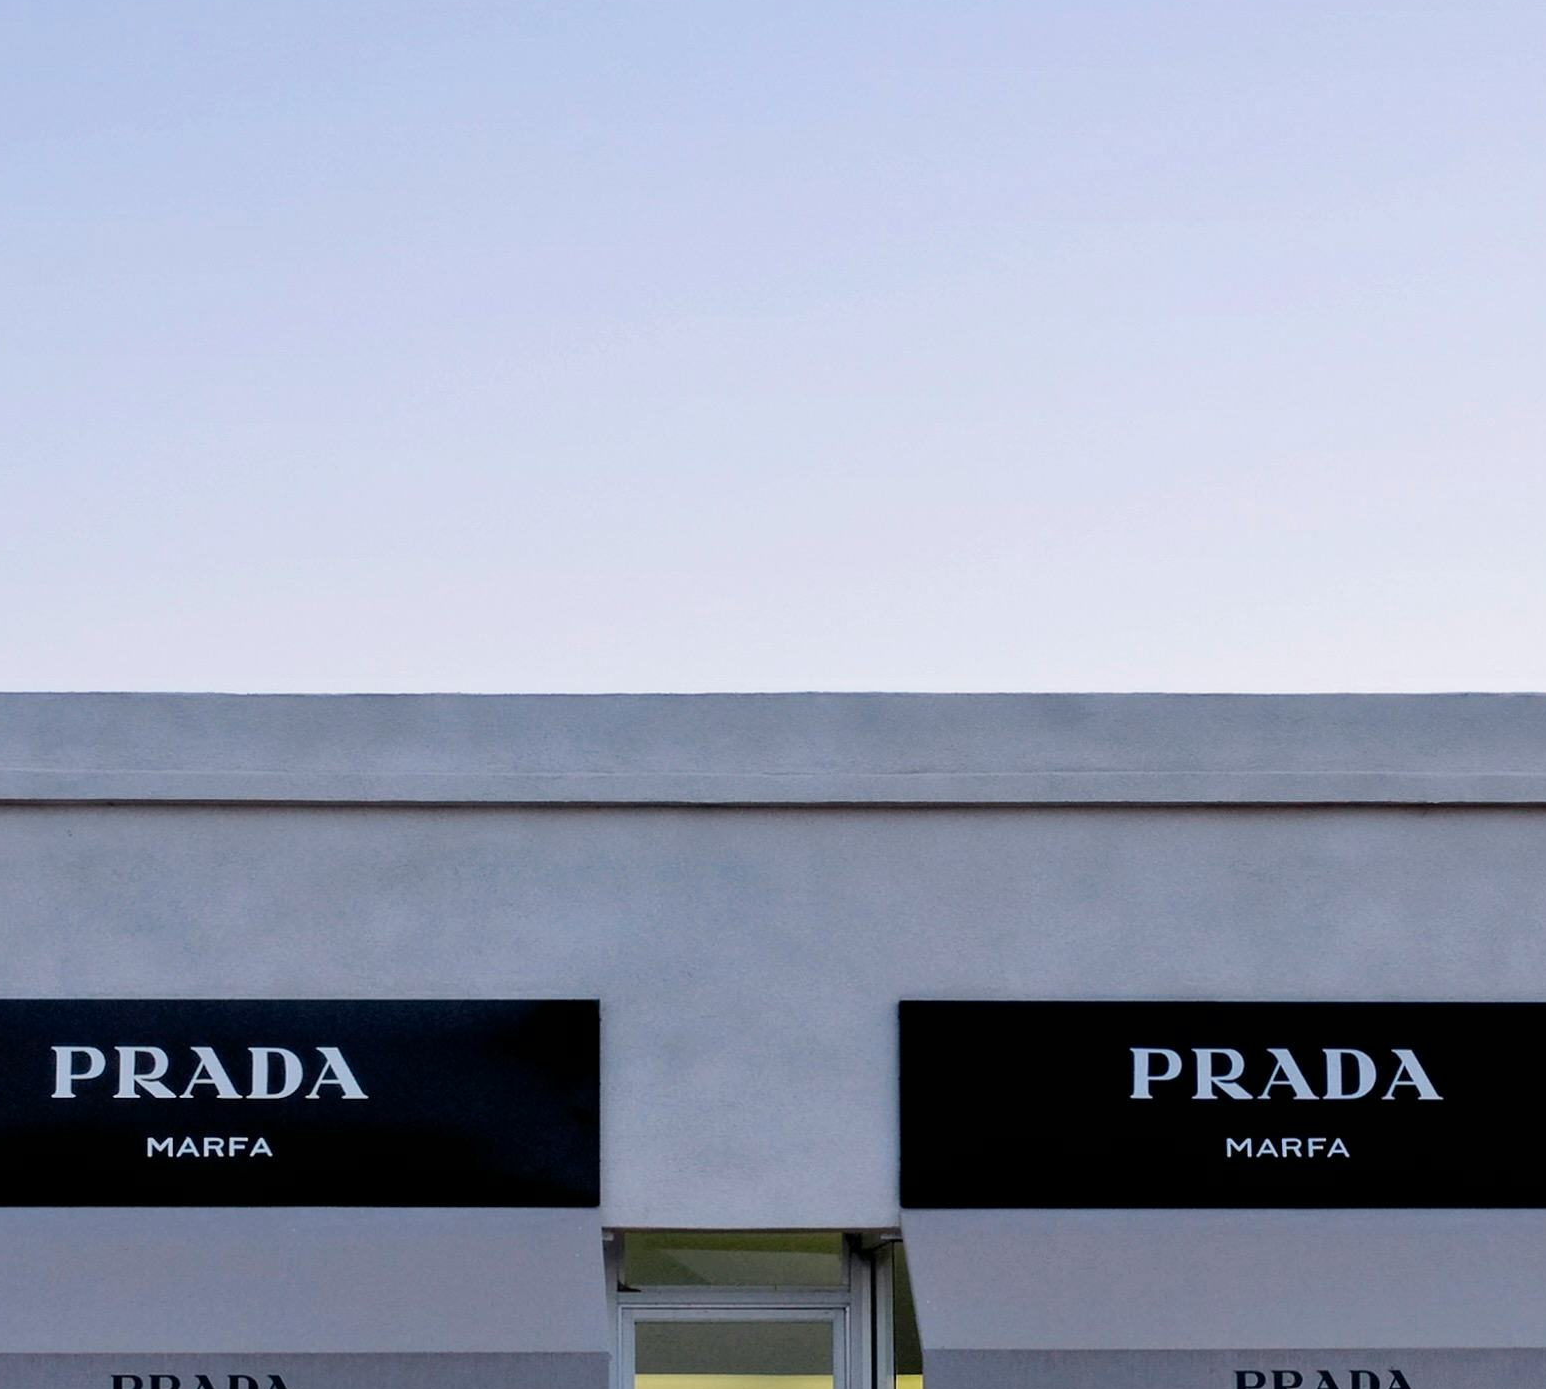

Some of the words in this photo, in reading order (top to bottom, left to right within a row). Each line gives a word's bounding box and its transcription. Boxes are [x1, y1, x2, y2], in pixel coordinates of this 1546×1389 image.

[50, 1046, 369, 1100] PRADA
[1128, 1047, 1444, 1100] PRADA
[146, 1136, 274, 1158] MARFA
[1226, 1136, 1351, 1159] MARFA
